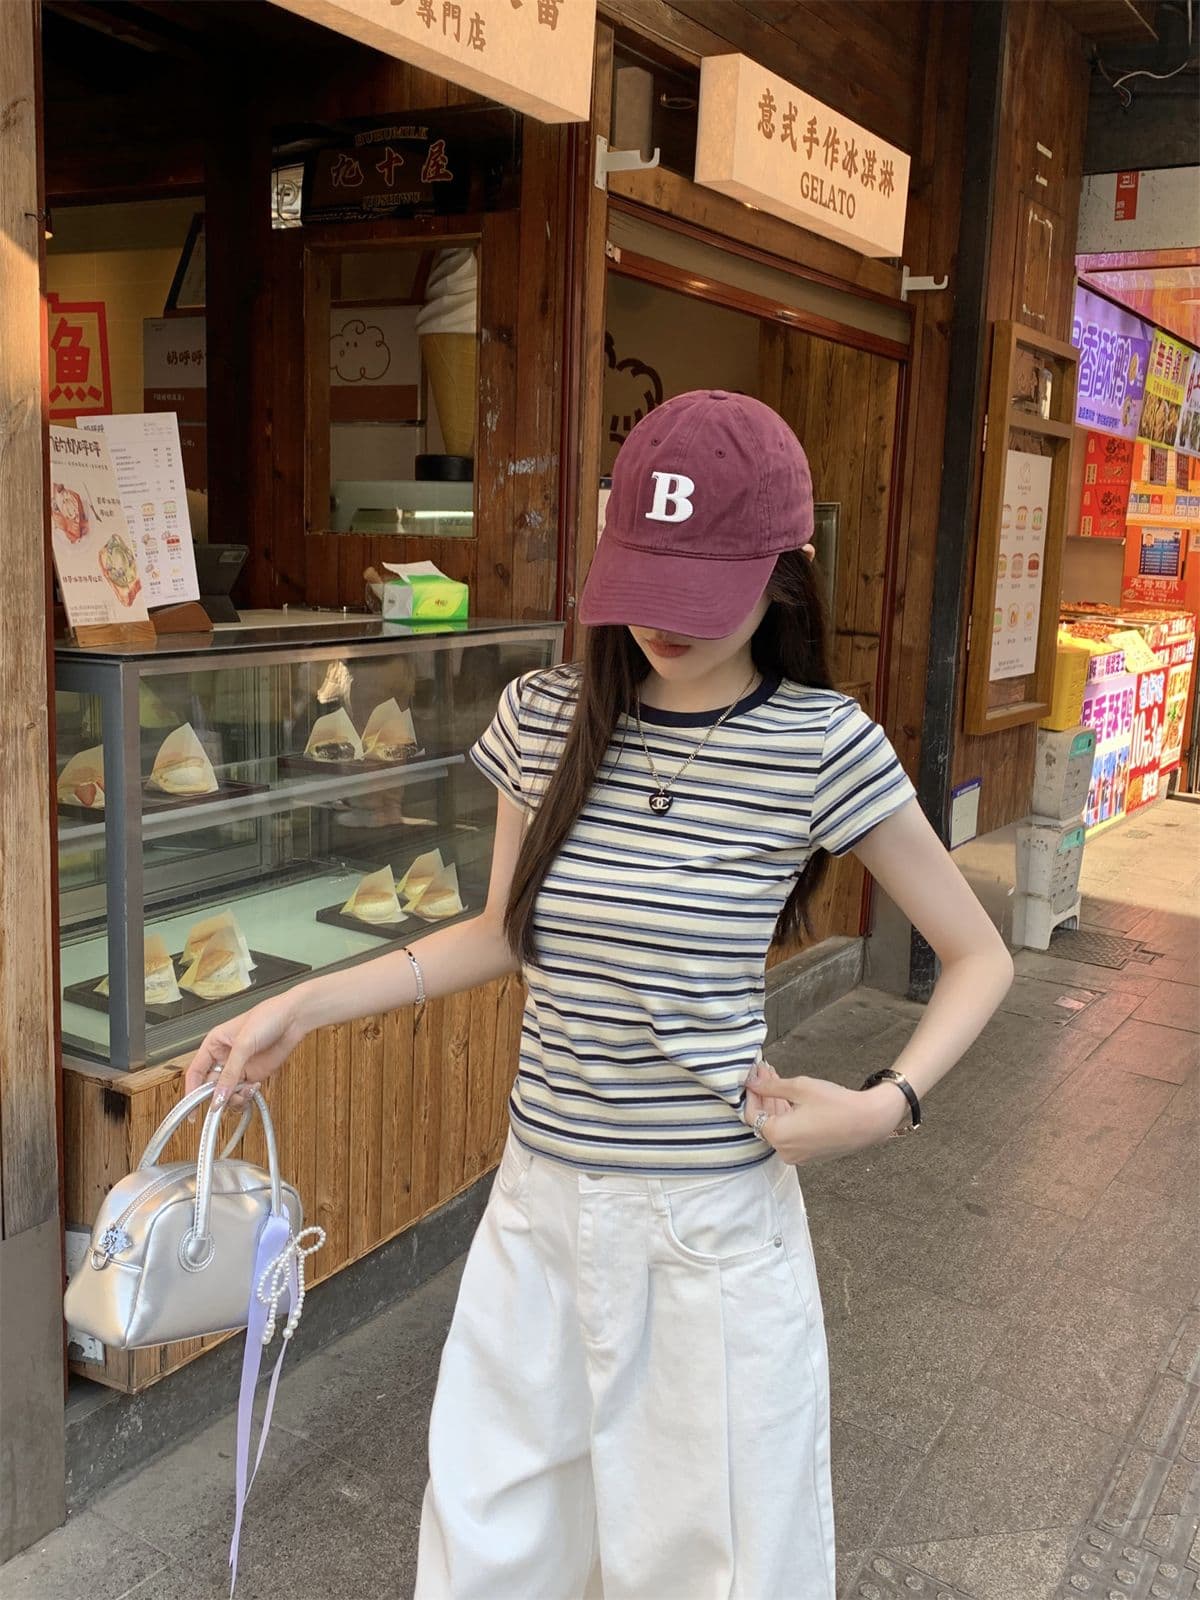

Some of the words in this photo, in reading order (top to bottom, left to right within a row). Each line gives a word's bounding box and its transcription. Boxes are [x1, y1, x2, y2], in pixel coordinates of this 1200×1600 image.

[390, 0, 486, 51] 專門店
[757, 87, 895, 199] 意式手作冰淇淋
[800, 171, 856, 219] GELATO
[645, 471, 695, 523] B
